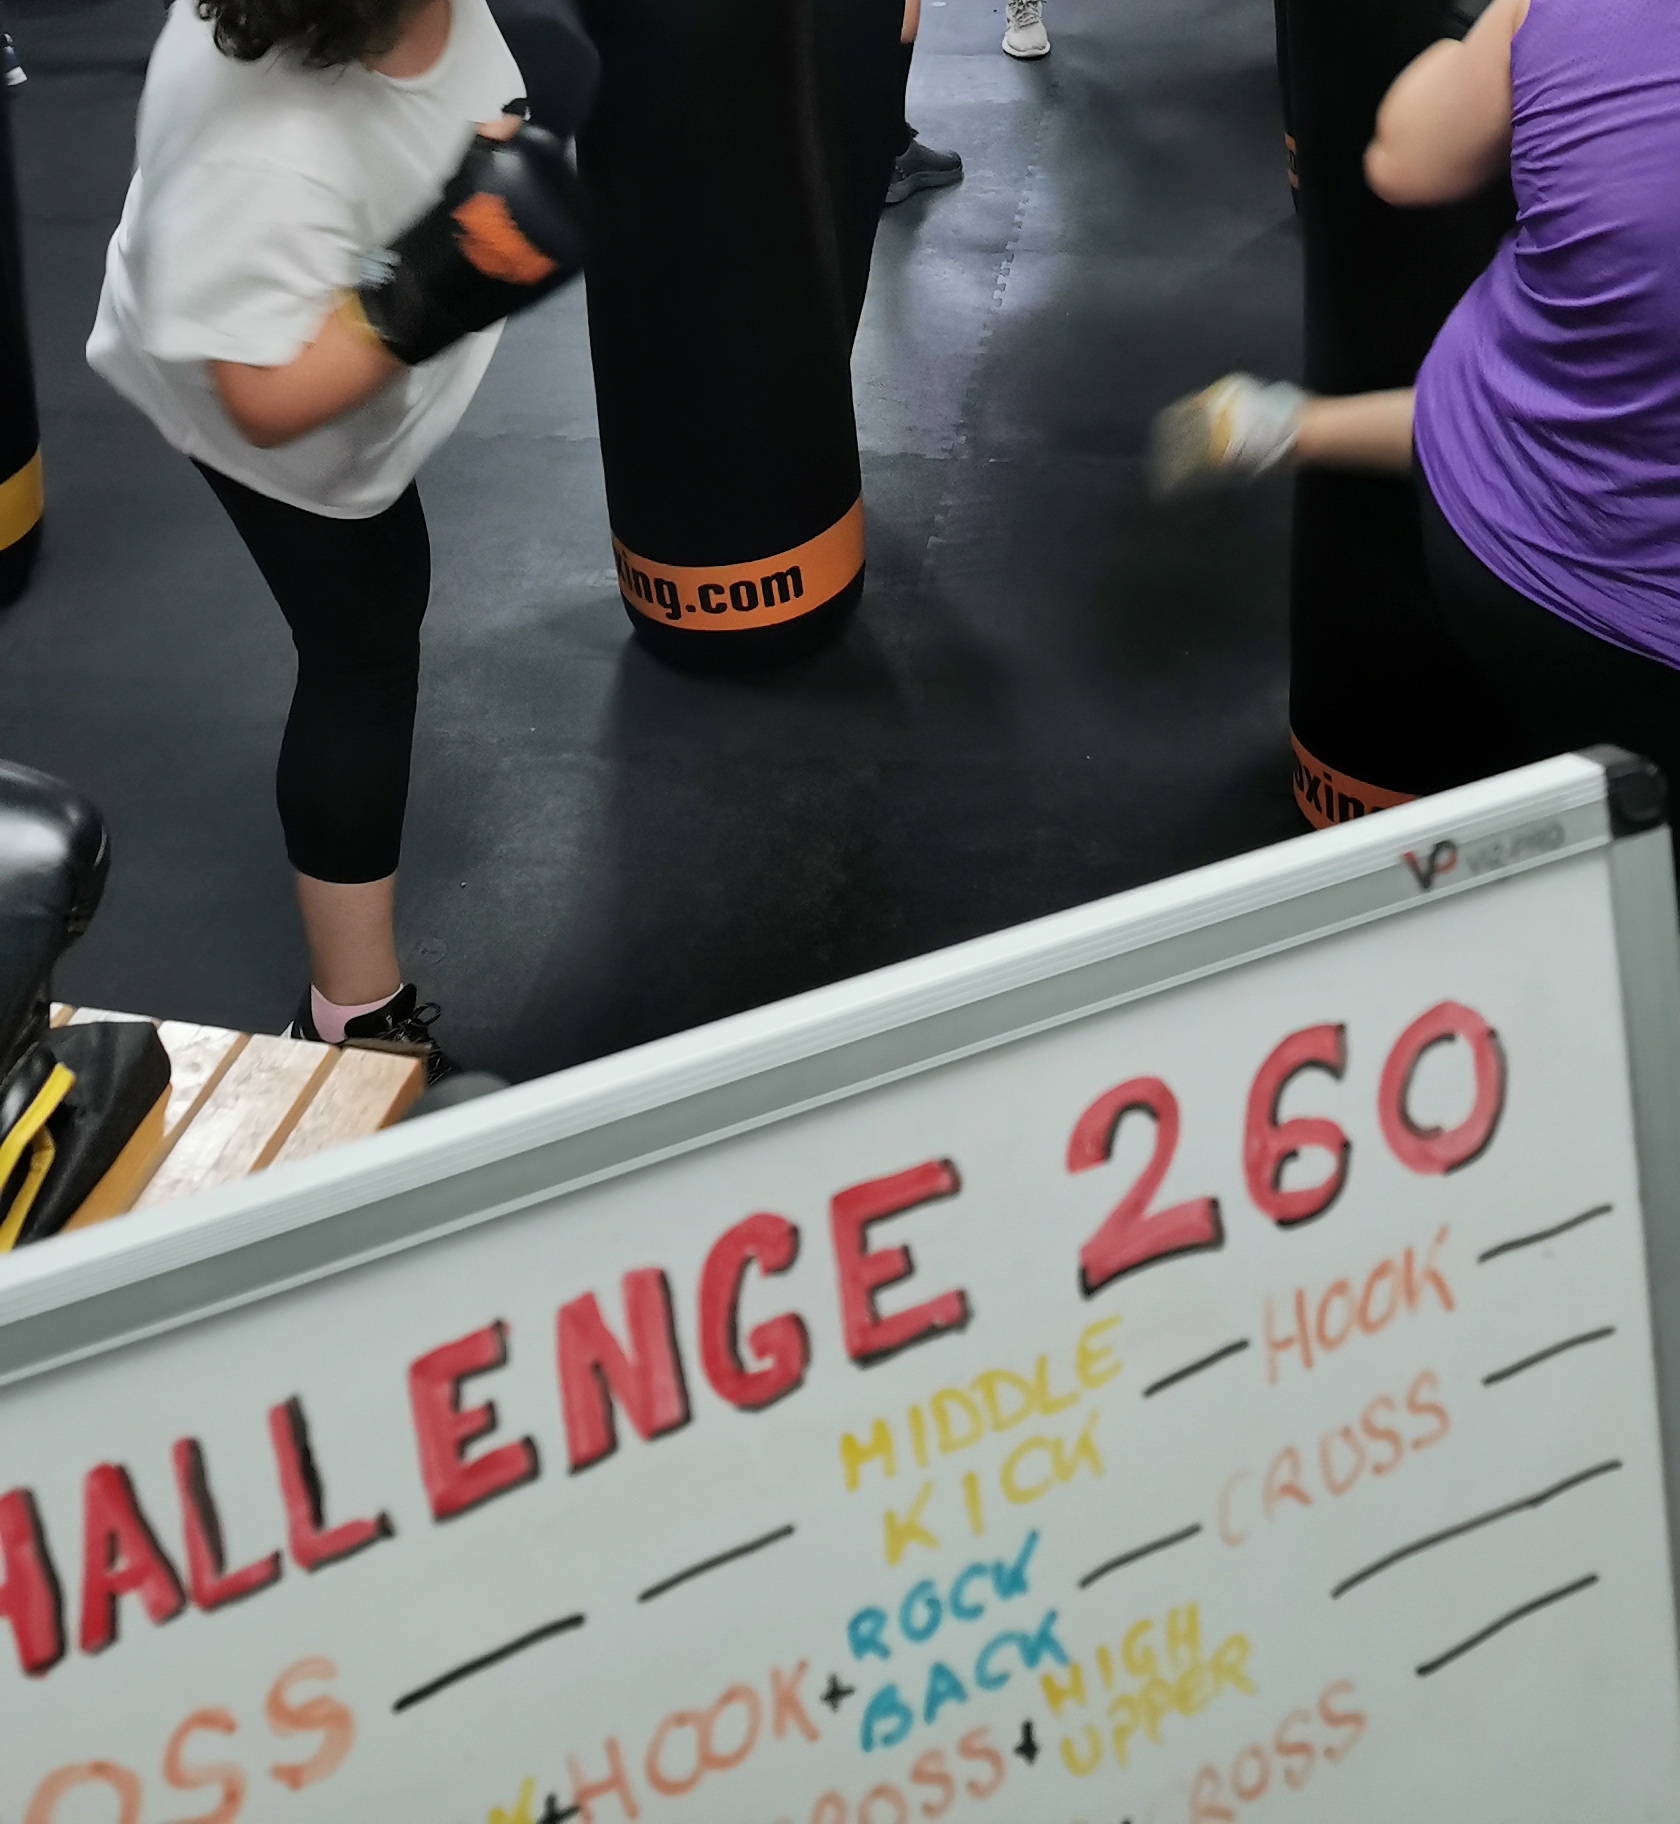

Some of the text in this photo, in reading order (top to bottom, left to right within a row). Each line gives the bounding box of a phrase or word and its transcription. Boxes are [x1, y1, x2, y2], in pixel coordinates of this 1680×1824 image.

[1065, 999, 1509, 1300] 260
[839, 1315, 1123, 1492] MIDDLE
[882, 1223, 1455, 1566] KICK HOOK
[847, 1369, 1452, 1662] ROCK CROSS
[567, 1658, 820, 1824] HOOK
[860, 1609, 1071, 1753] BACK
[1040, 1601, 1200, 1717] HIGH
[1059, 1632, 1258, 1778] UPPER
